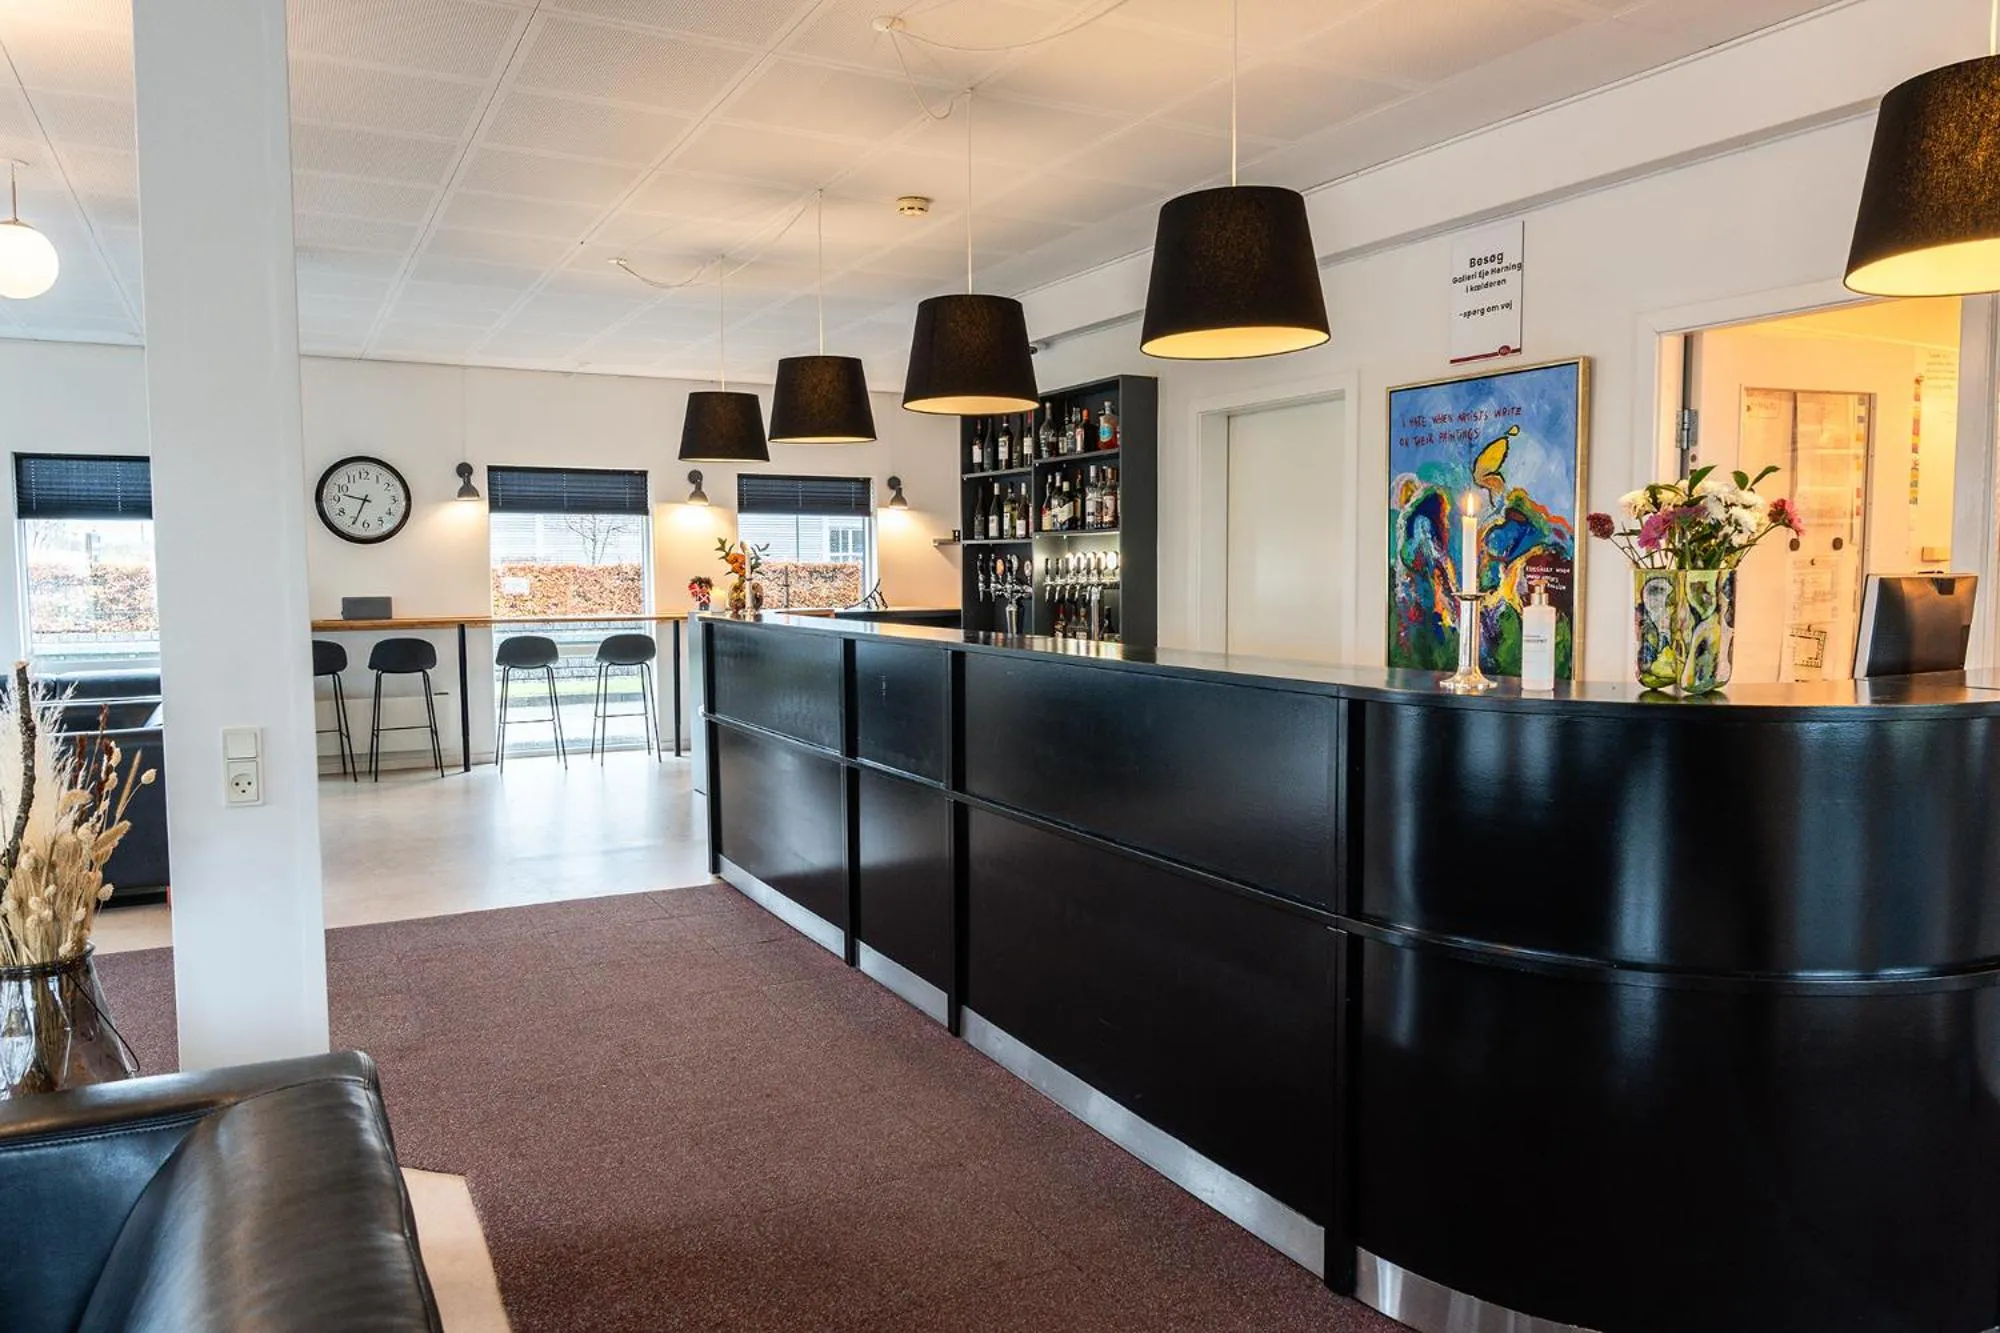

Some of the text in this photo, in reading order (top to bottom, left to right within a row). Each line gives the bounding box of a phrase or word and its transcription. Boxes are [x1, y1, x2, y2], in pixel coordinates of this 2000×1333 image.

[1452, 262, 1522, 284] Galleri Eje Herning
[1408, 415, 1427, 429] HATE
[1431, 414, 1453, 425] WHEN
[1458, 411, 1489, 423] ARTISTS
[1495, 407, 1522, 418] WRITE
[1413, 434, 1434, 447] THEIR
[1439, 428, 1481, 443] PAINTINGS
[347, 472, 356, 484] 11
[358, 470, 370, 481] 12
[338, 484, 349, 493] 10
[383, 482, 391, 492] 2
[333, 495, 341, 504] 9
[392, 496, 398, 504] 3
[338, 507, 345, 516] 8
[385, 508, 392, 517] 4
[362, 520, 370, 531] 6
[377, 517, 384, 526] 5
